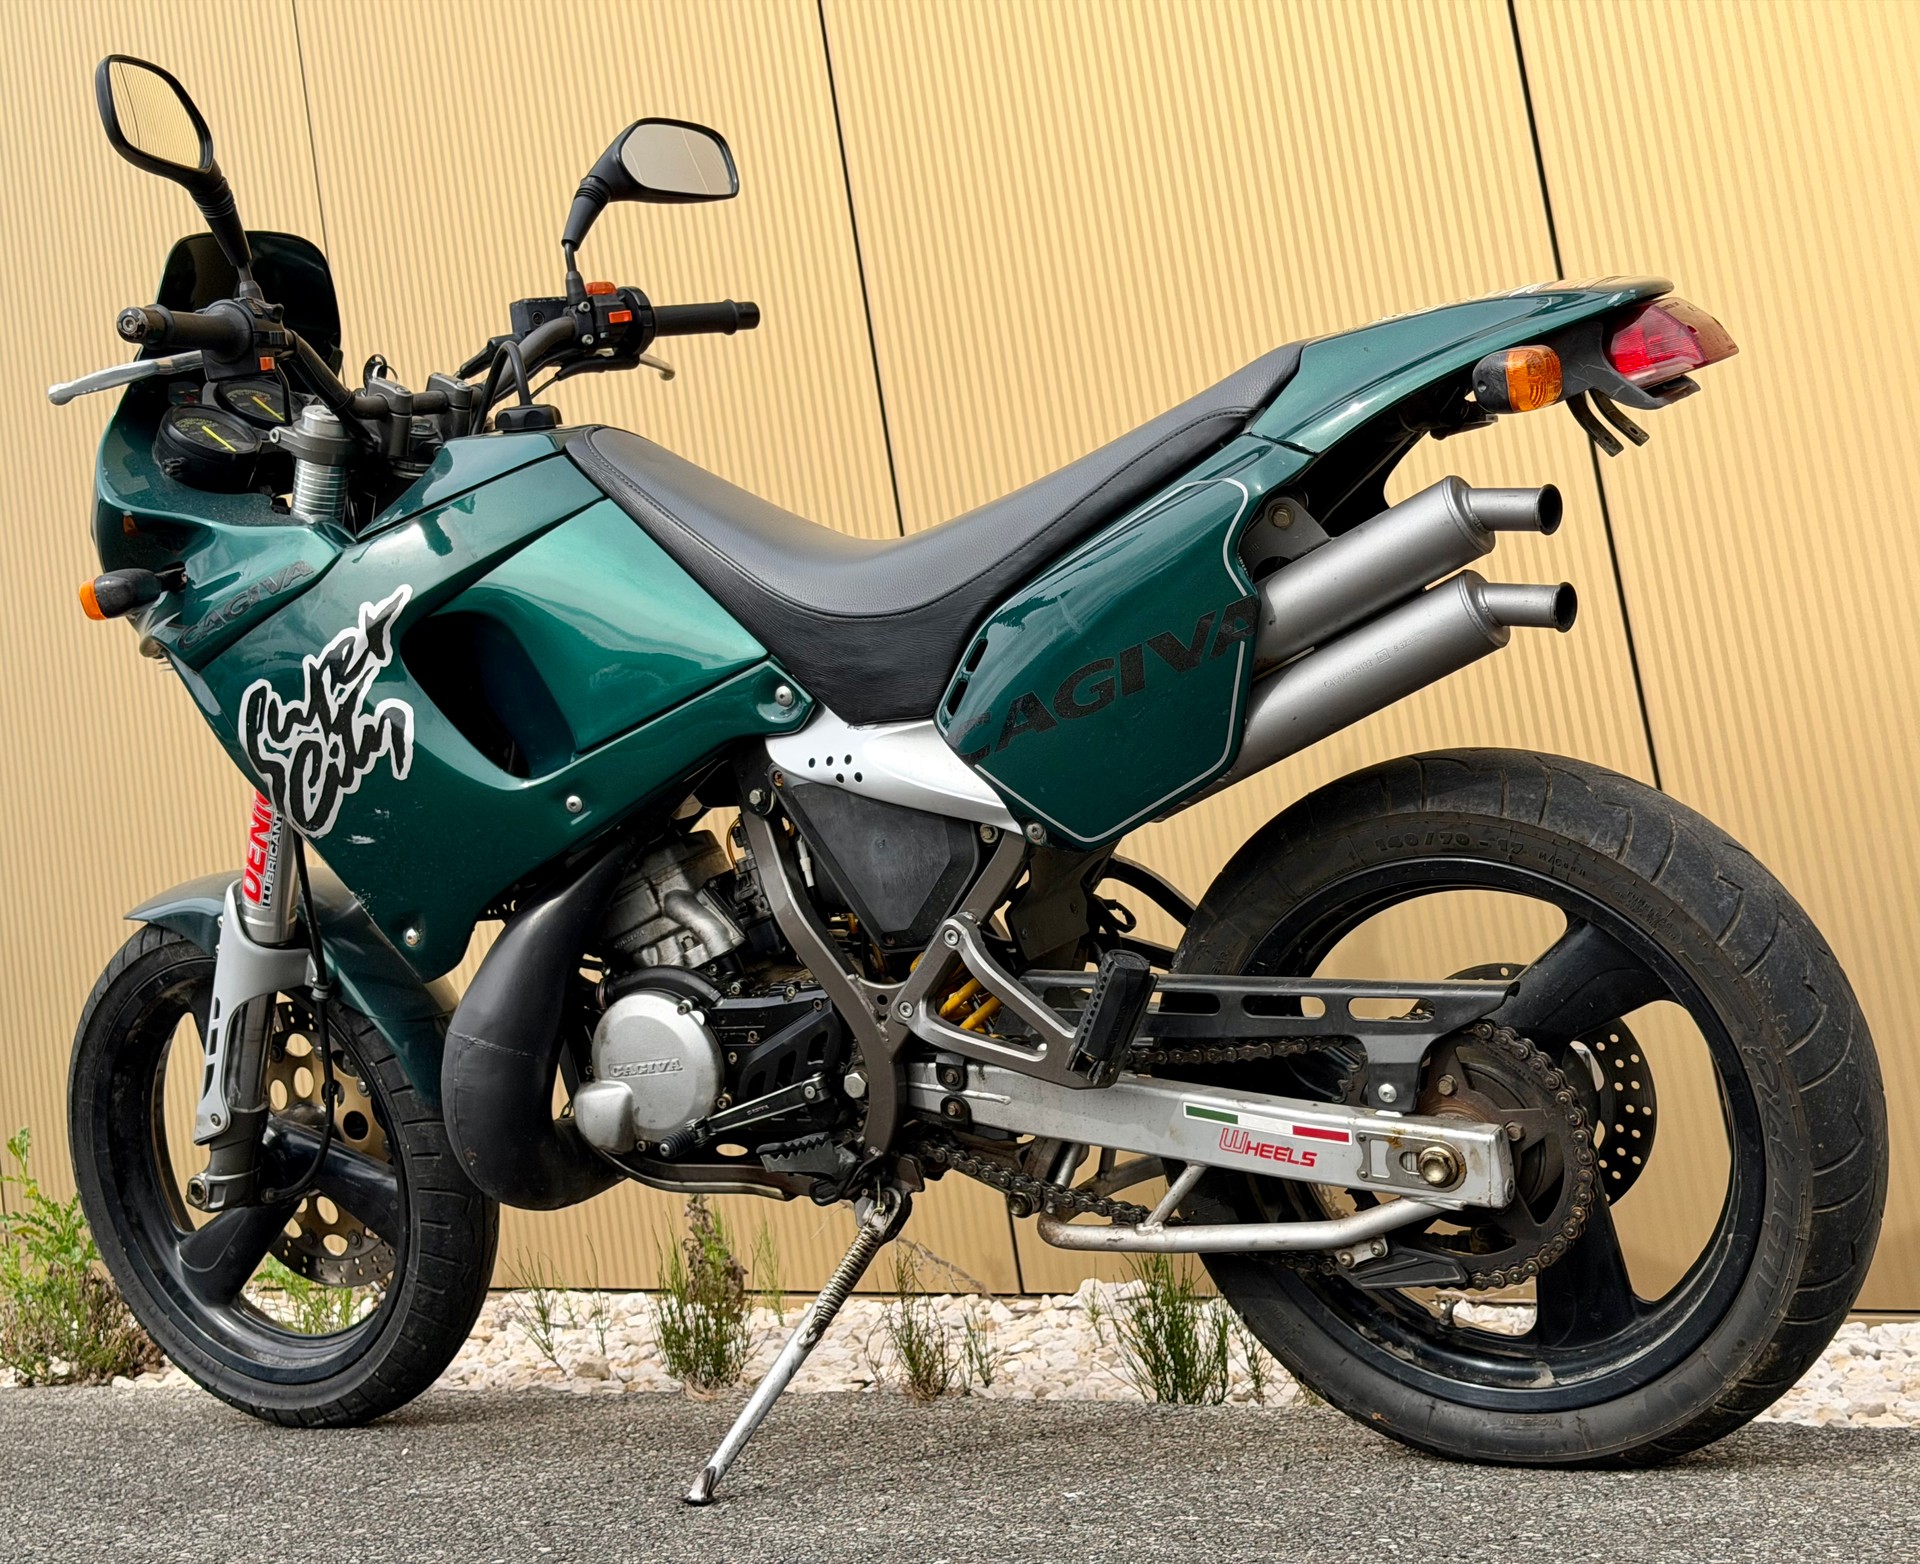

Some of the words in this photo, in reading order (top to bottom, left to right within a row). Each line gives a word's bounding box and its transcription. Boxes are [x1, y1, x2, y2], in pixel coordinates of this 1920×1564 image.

[176, 559, 315, 650] CAGIVA
[945, 594, 1258, 765] CAGIVA
[610, 1058, 683, 1077] CAGIVA
[1218, 1127, 1318, 1168] WHEELS
